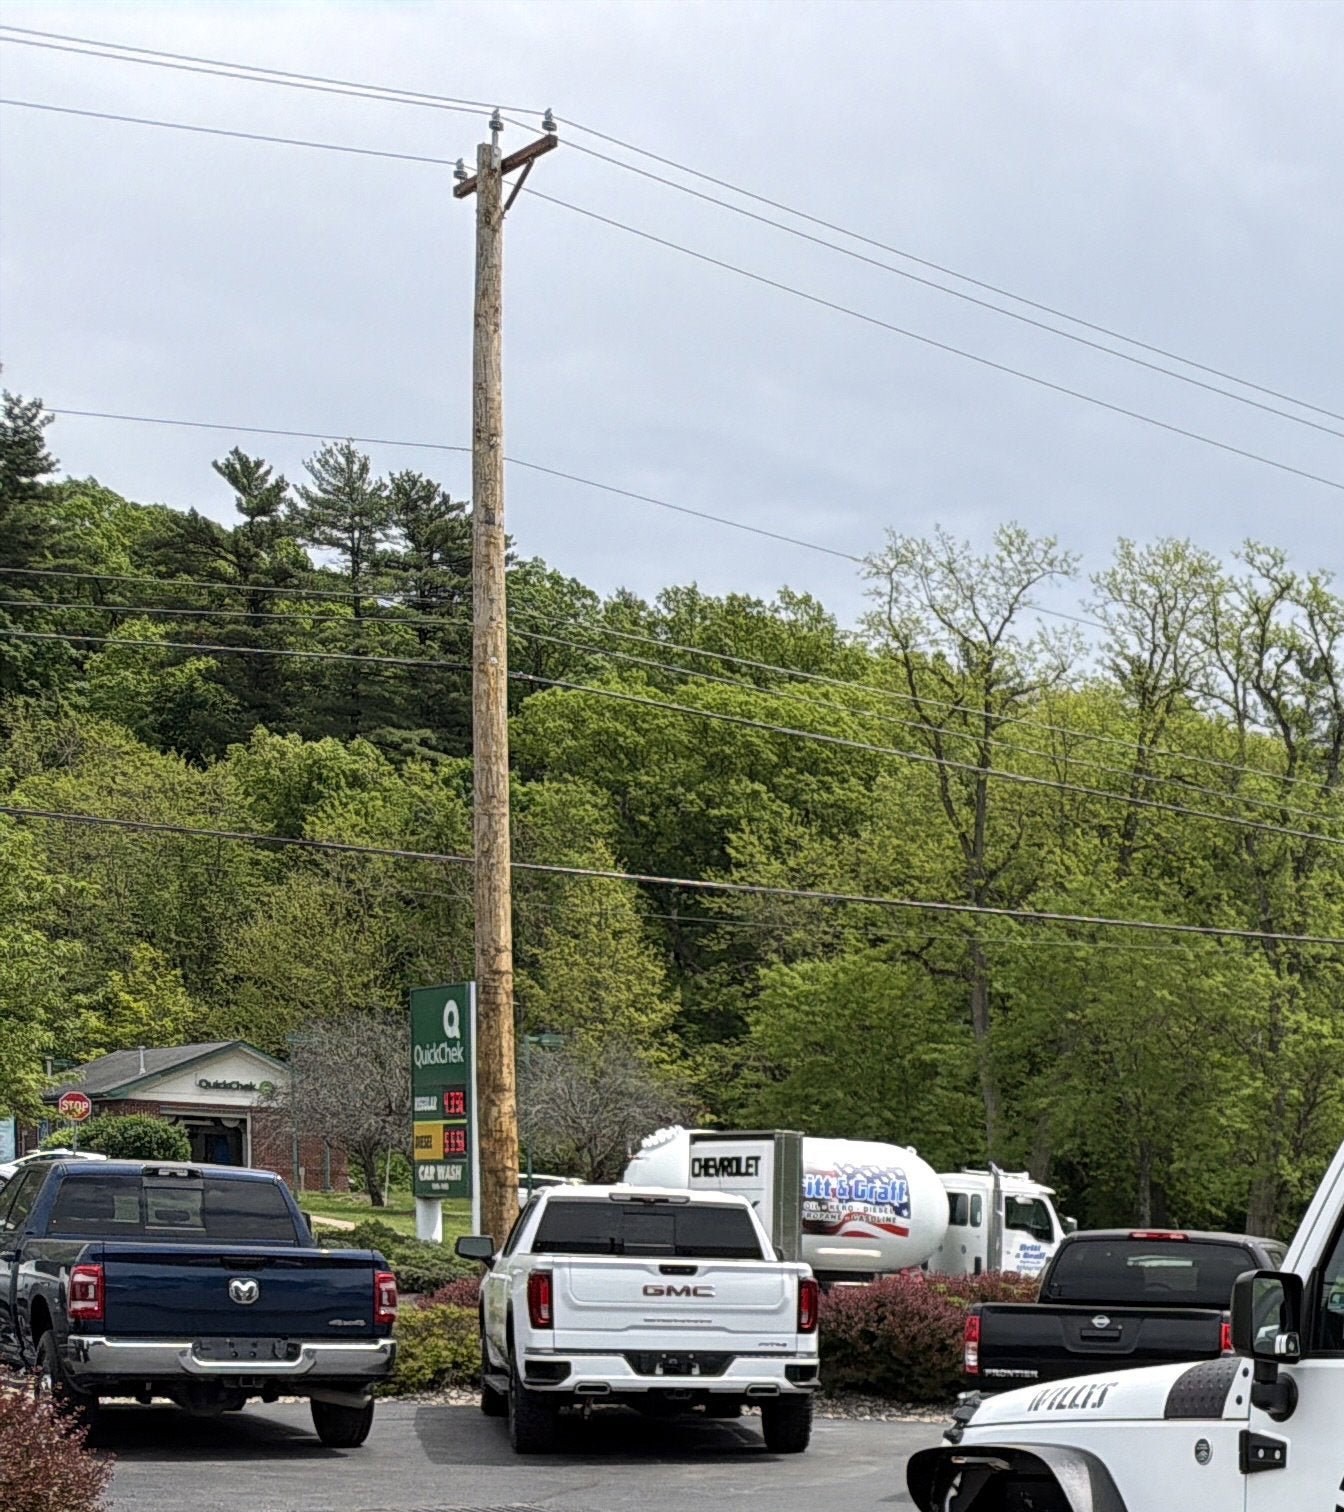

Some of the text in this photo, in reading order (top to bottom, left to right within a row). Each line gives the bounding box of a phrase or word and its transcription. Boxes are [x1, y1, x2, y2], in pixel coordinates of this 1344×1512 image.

[414, 1041, 465, 1069] QuickChek
[62, 1101, 89, 1113] STOP
[419, 1165, 462, 1181] CAR WASH
[691, 1156, 761, 1177] CHEVROLET
[804, 1175, 907, 1203] itt & Graff
[863, 1204, 895, 1214] DIESEL
[642, 1285, 716, 1297] GMC
[984, 1368, 1039, 1378] FRONTIER
